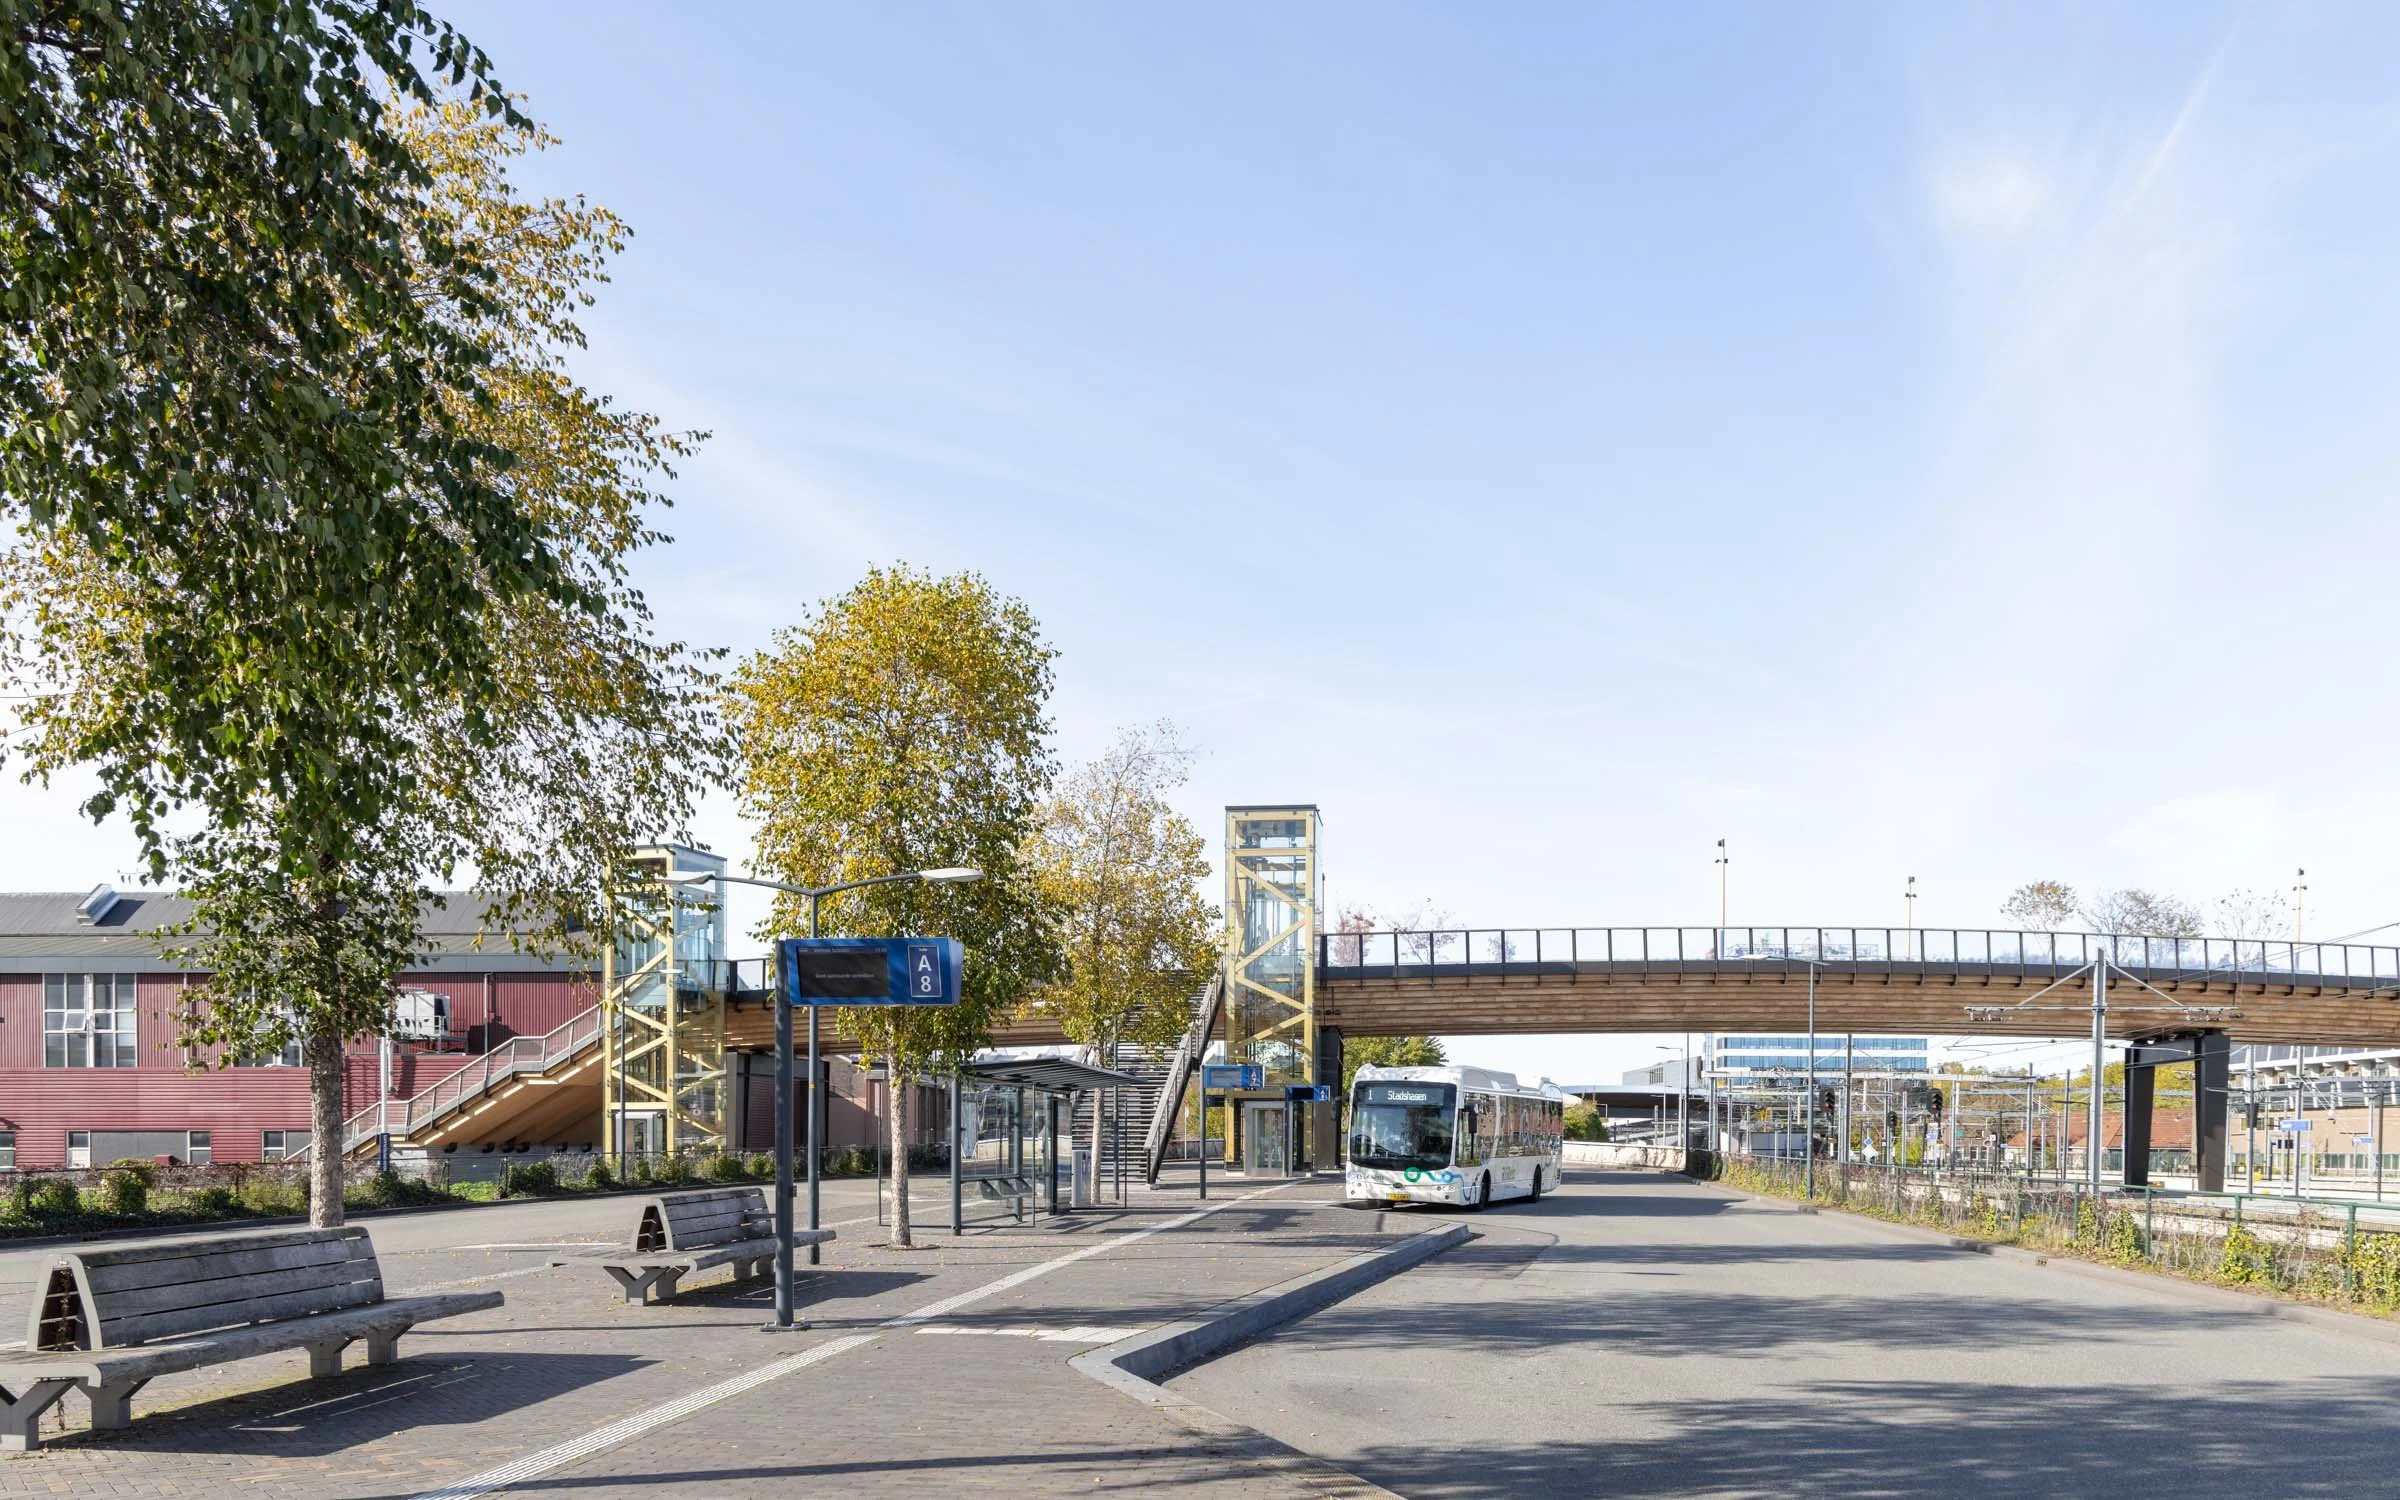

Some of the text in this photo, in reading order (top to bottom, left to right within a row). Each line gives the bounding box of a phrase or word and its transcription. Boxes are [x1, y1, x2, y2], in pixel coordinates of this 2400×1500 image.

[918, 955, 932, 972] A
[920, 975, 932, 992] 8
[1368, 1089, 1427, 1101] 1 Stadshagen
